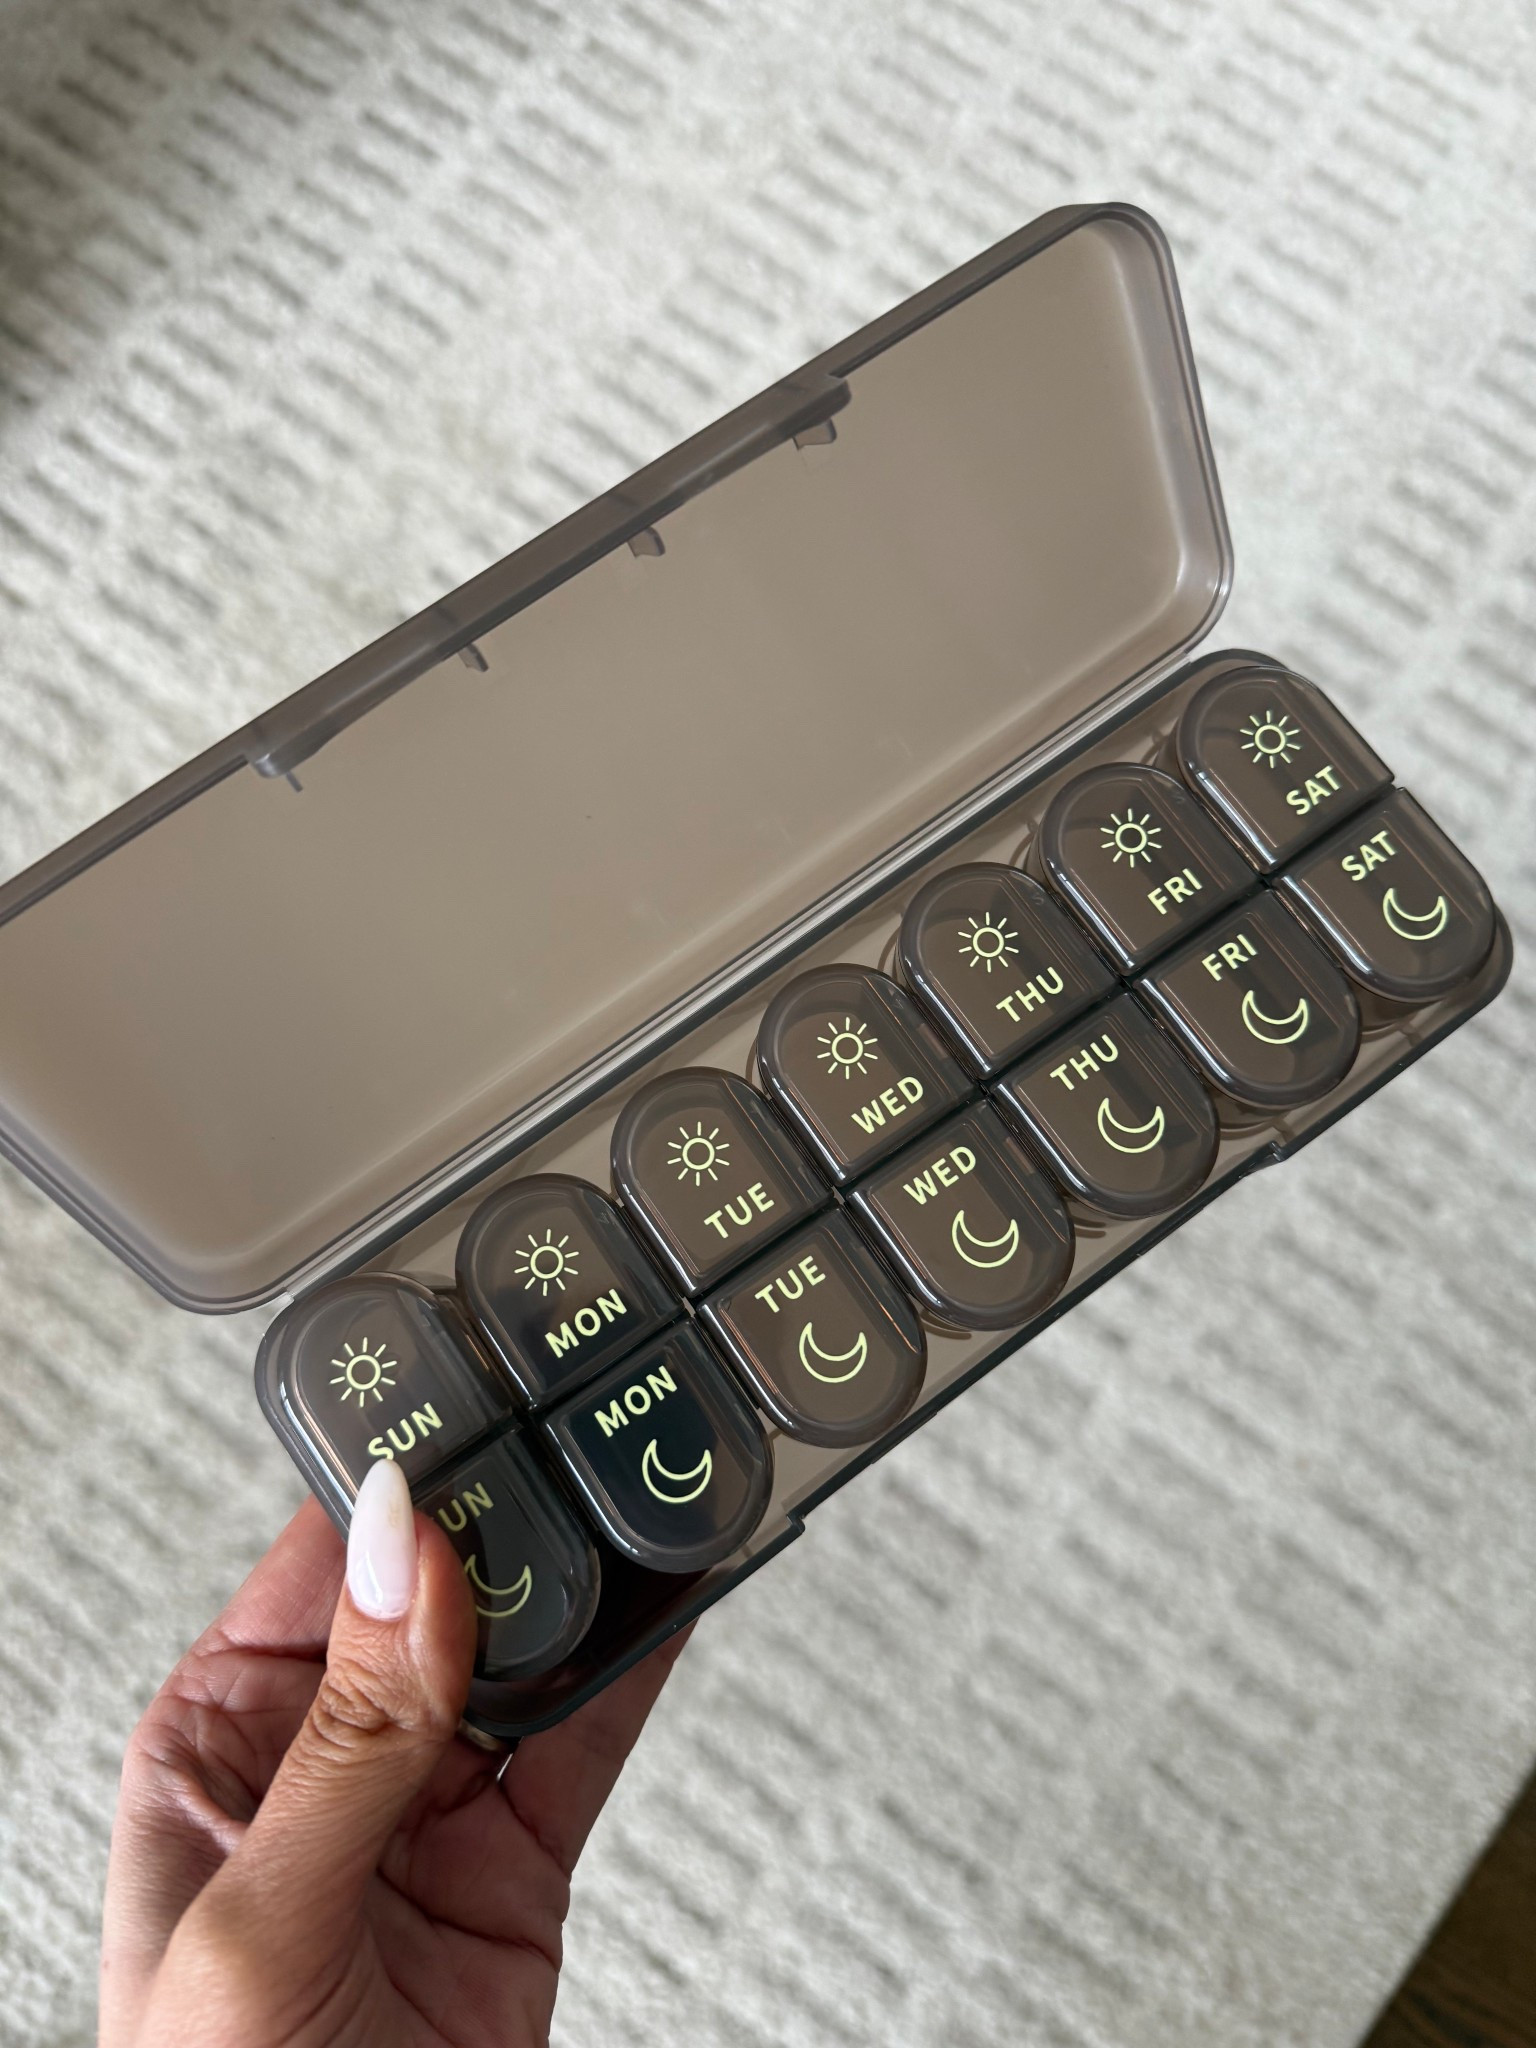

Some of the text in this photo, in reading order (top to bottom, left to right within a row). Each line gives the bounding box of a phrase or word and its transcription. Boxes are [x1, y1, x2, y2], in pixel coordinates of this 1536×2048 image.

[1285, 767, 1339, 816] SAT
[1341, 831, 1395, 881] SAT
[1147, 869, 1201, 915] FRI
[1201, 934, 1255, 981] FRI
[996, 967, 1064, 1023] THU
[1049, 1035, 1119, 1090] THU
[851, 1076, 924, 1135] WED
[902, 1146, 976, 1206] WED
[703, 1183, 774, 1239] TUE
[754, 1255, 826, 1313] TUE
[545, 1289, 626, 1358] MON
[595, 1365, 677, 1438] MON
[367, 1403, 444, 1461] SUN
[437, 1481, 494, 1534] UN
